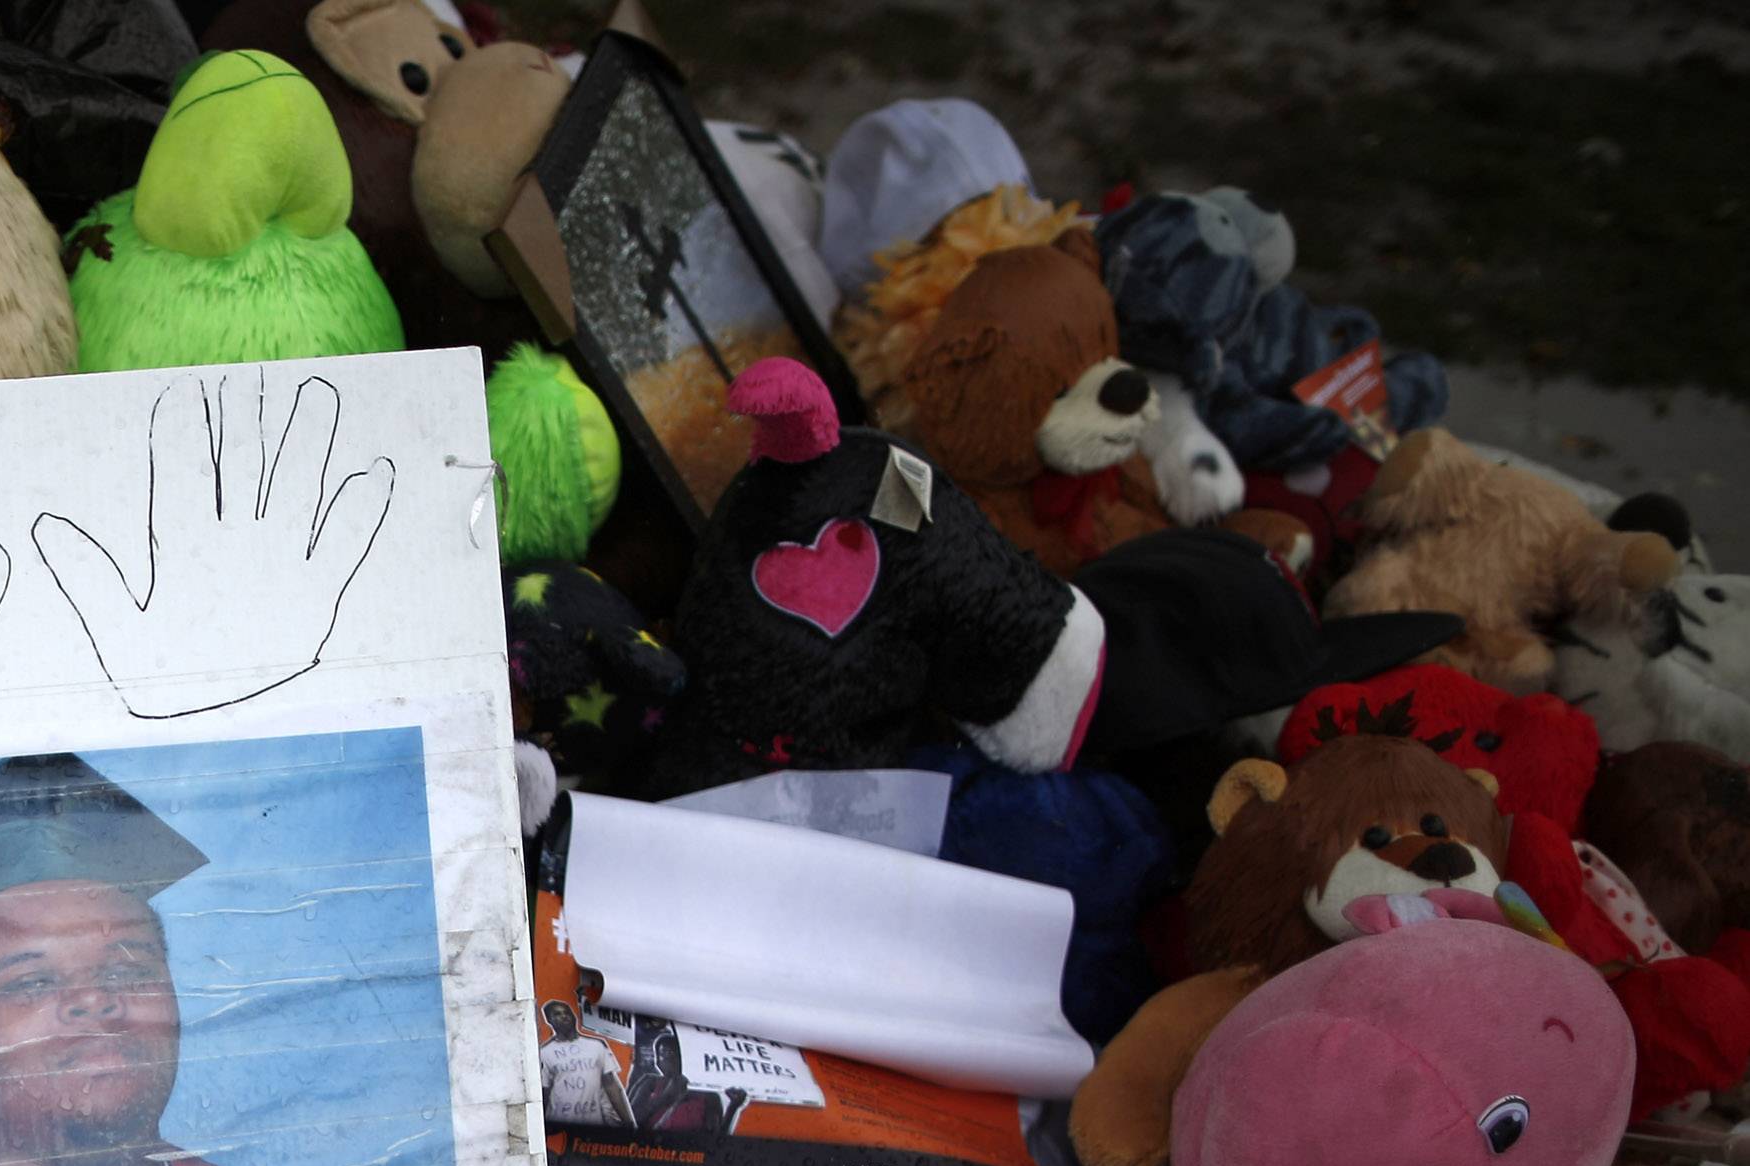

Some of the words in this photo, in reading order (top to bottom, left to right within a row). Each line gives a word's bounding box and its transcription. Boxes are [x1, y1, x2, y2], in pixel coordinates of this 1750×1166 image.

[598, 1006, 633, 1029] MAN
[554, 1044, 580, 1060] NO
[721, 1037, 772, 1061] LIFE
[703, 1052, 797, 1080] MATTERS
[563, 1076, 586, 1092] NO
[572, 1136, 706, 1165] FergusonOctober.com
